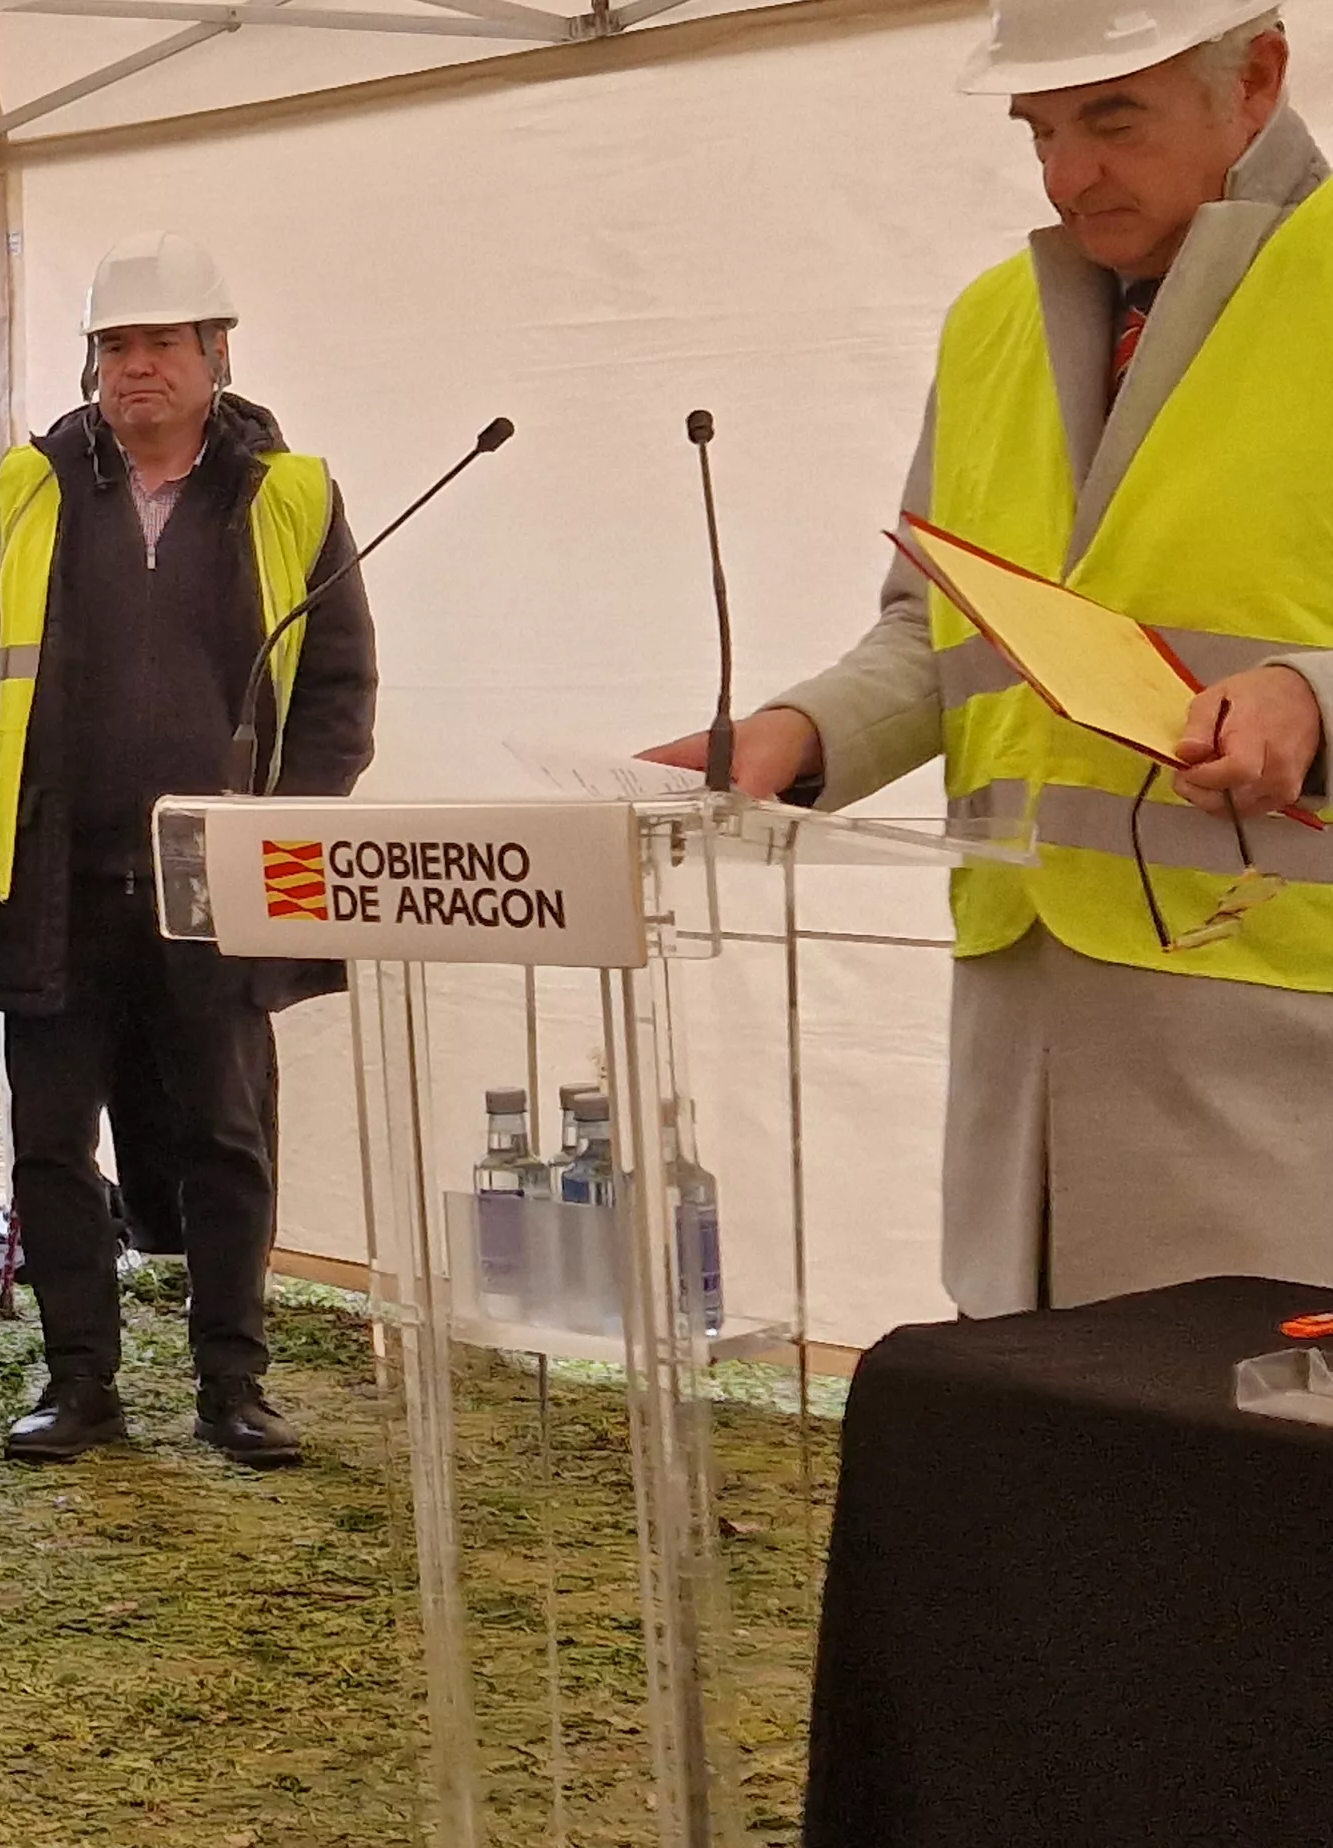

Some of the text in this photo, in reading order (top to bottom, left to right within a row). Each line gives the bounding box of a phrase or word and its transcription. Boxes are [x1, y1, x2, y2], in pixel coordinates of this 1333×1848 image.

[329, 840, 530, 882] GOBIERNO
[331, 884, 566, 929] DE ARAGON
